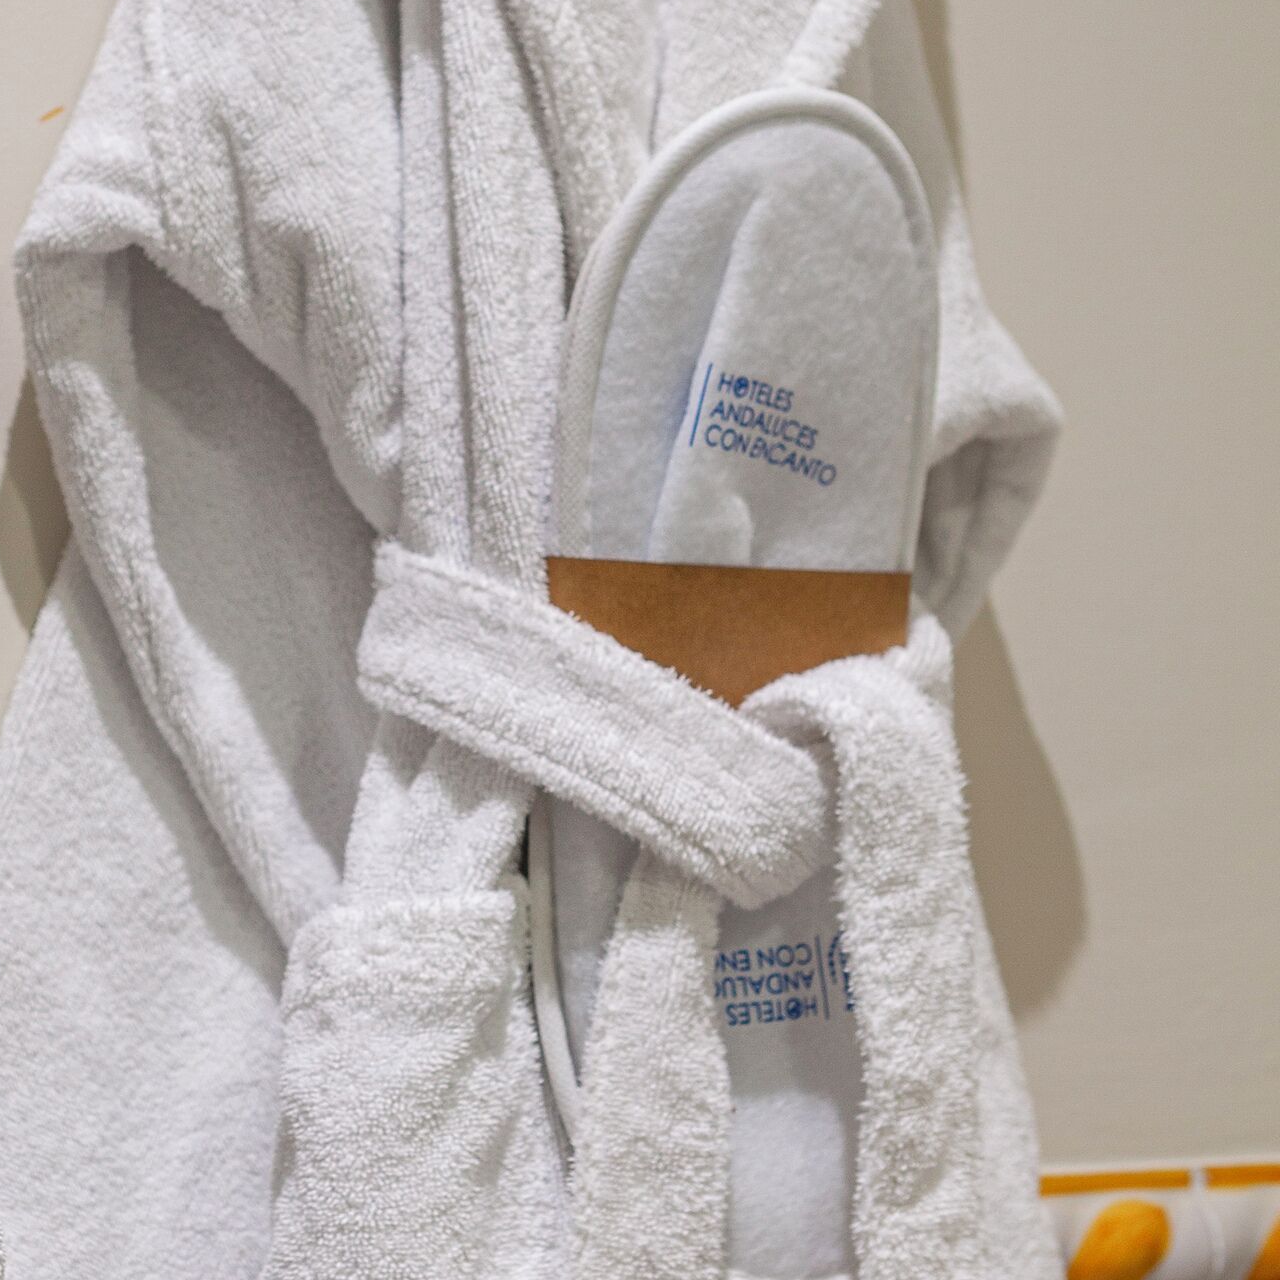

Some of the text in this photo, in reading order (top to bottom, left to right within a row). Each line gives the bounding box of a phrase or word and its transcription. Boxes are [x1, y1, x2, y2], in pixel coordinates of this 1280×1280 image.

[716, 372, 795, 412] HOTELES
[704, 423, 751, 453] CON
[709, 399, 818, 451] ANDALUCES
[756, 943, 812, 968] CON
[714, 971, 815, 998] ANDALU
[724, 993, 819, 1026] HOTELES
